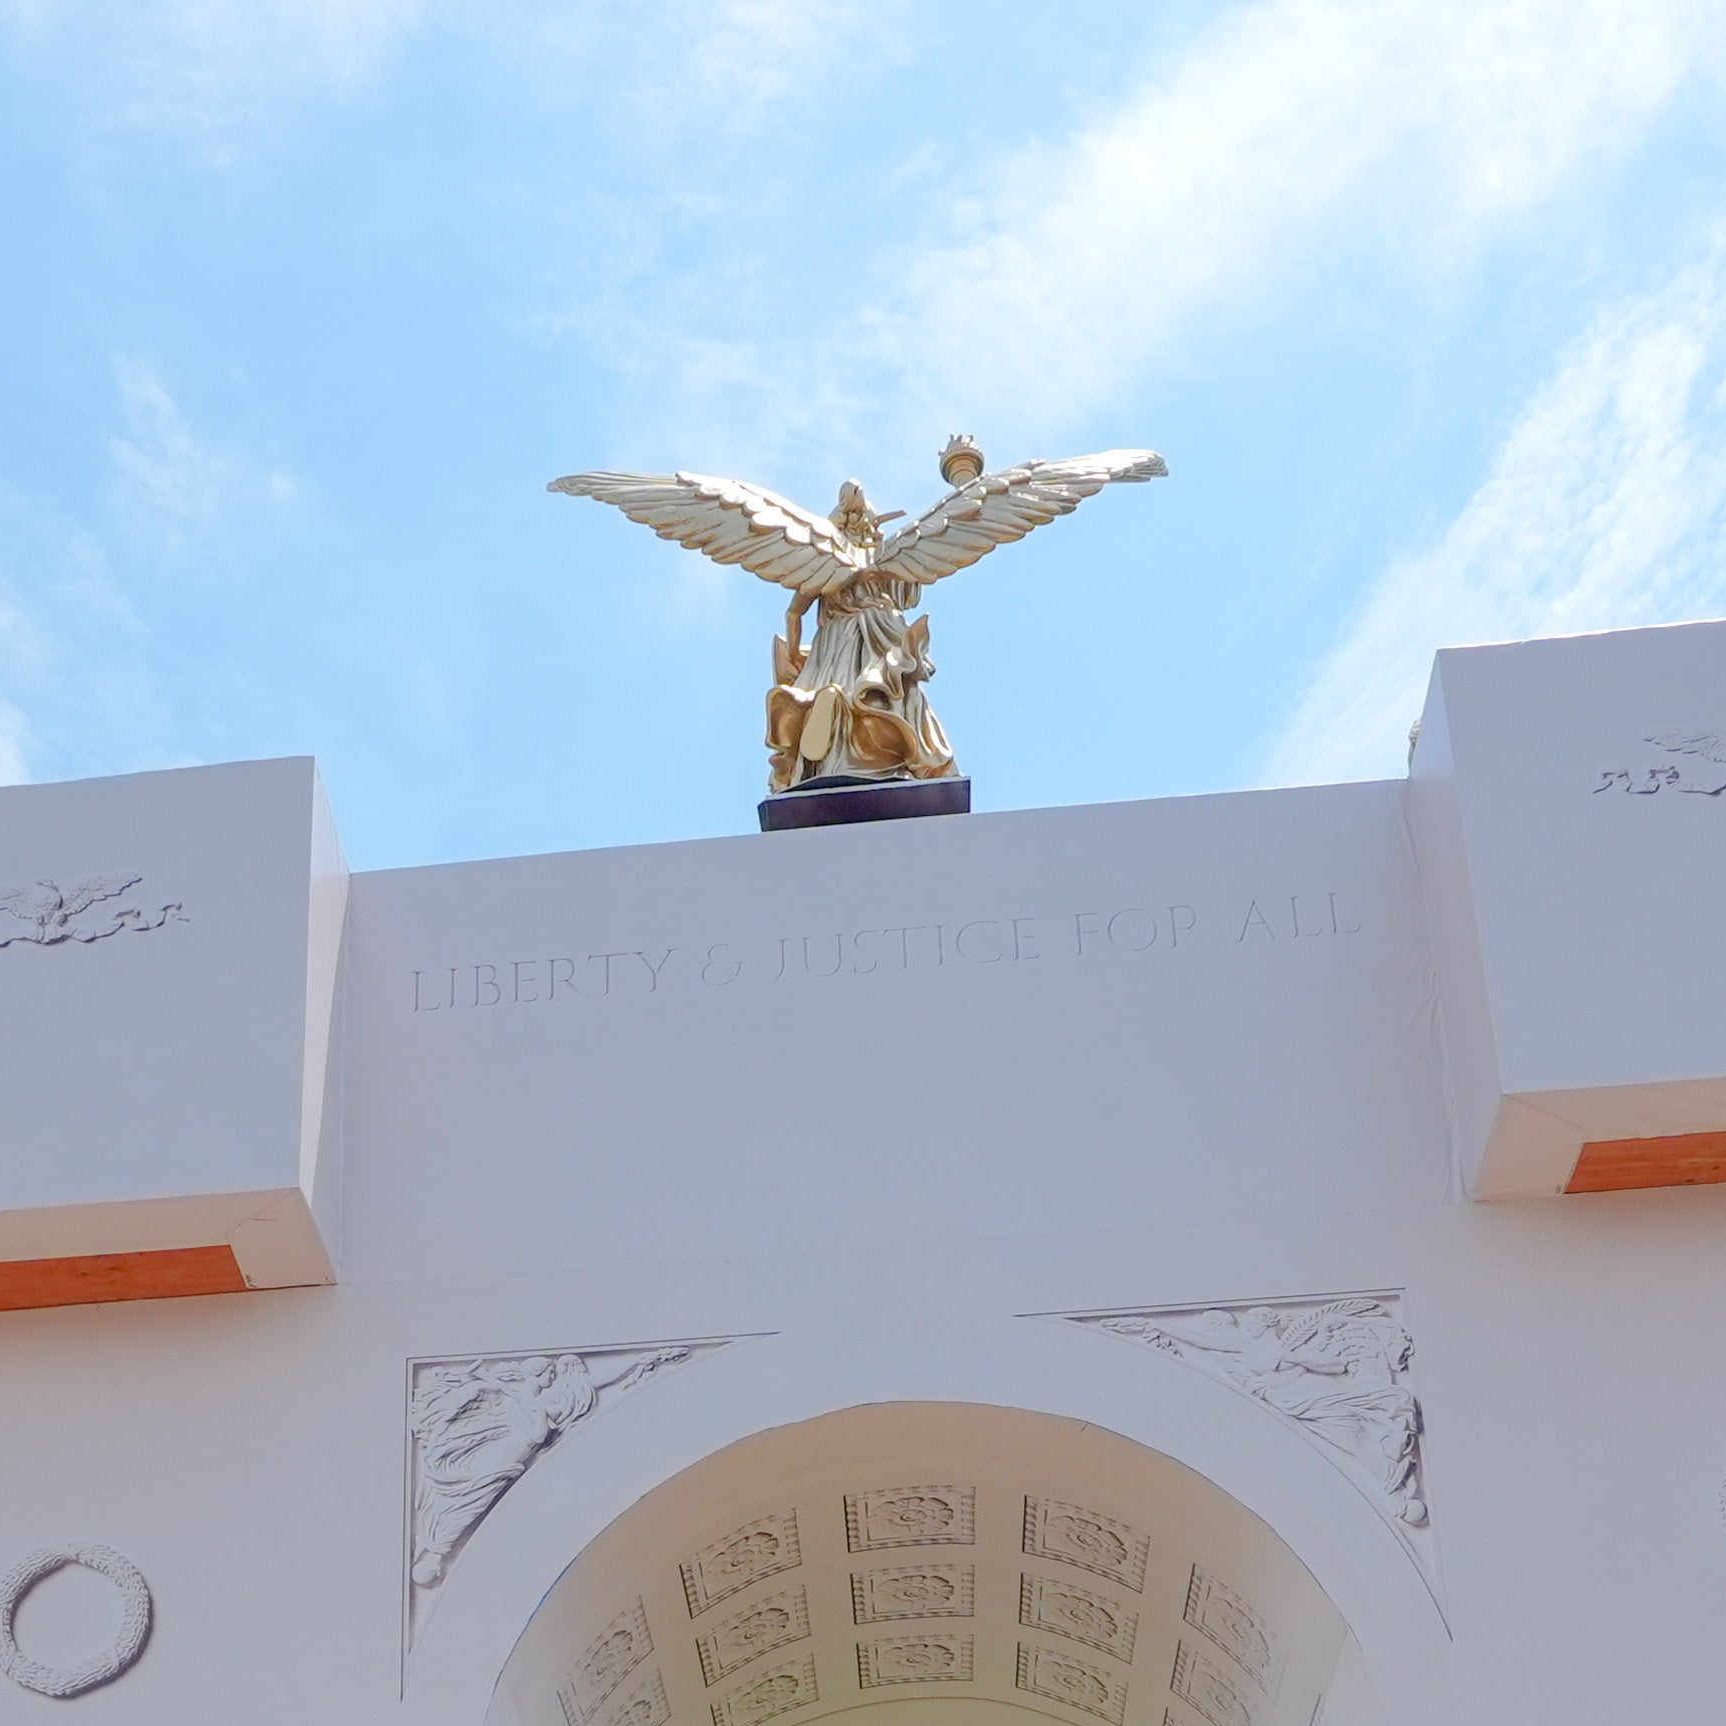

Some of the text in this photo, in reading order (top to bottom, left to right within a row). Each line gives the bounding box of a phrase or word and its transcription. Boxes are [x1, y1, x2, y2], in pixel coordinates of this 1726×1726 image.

[411, 892, 1361, 1012] LIBERTY & JUSTICE FOR ALL
